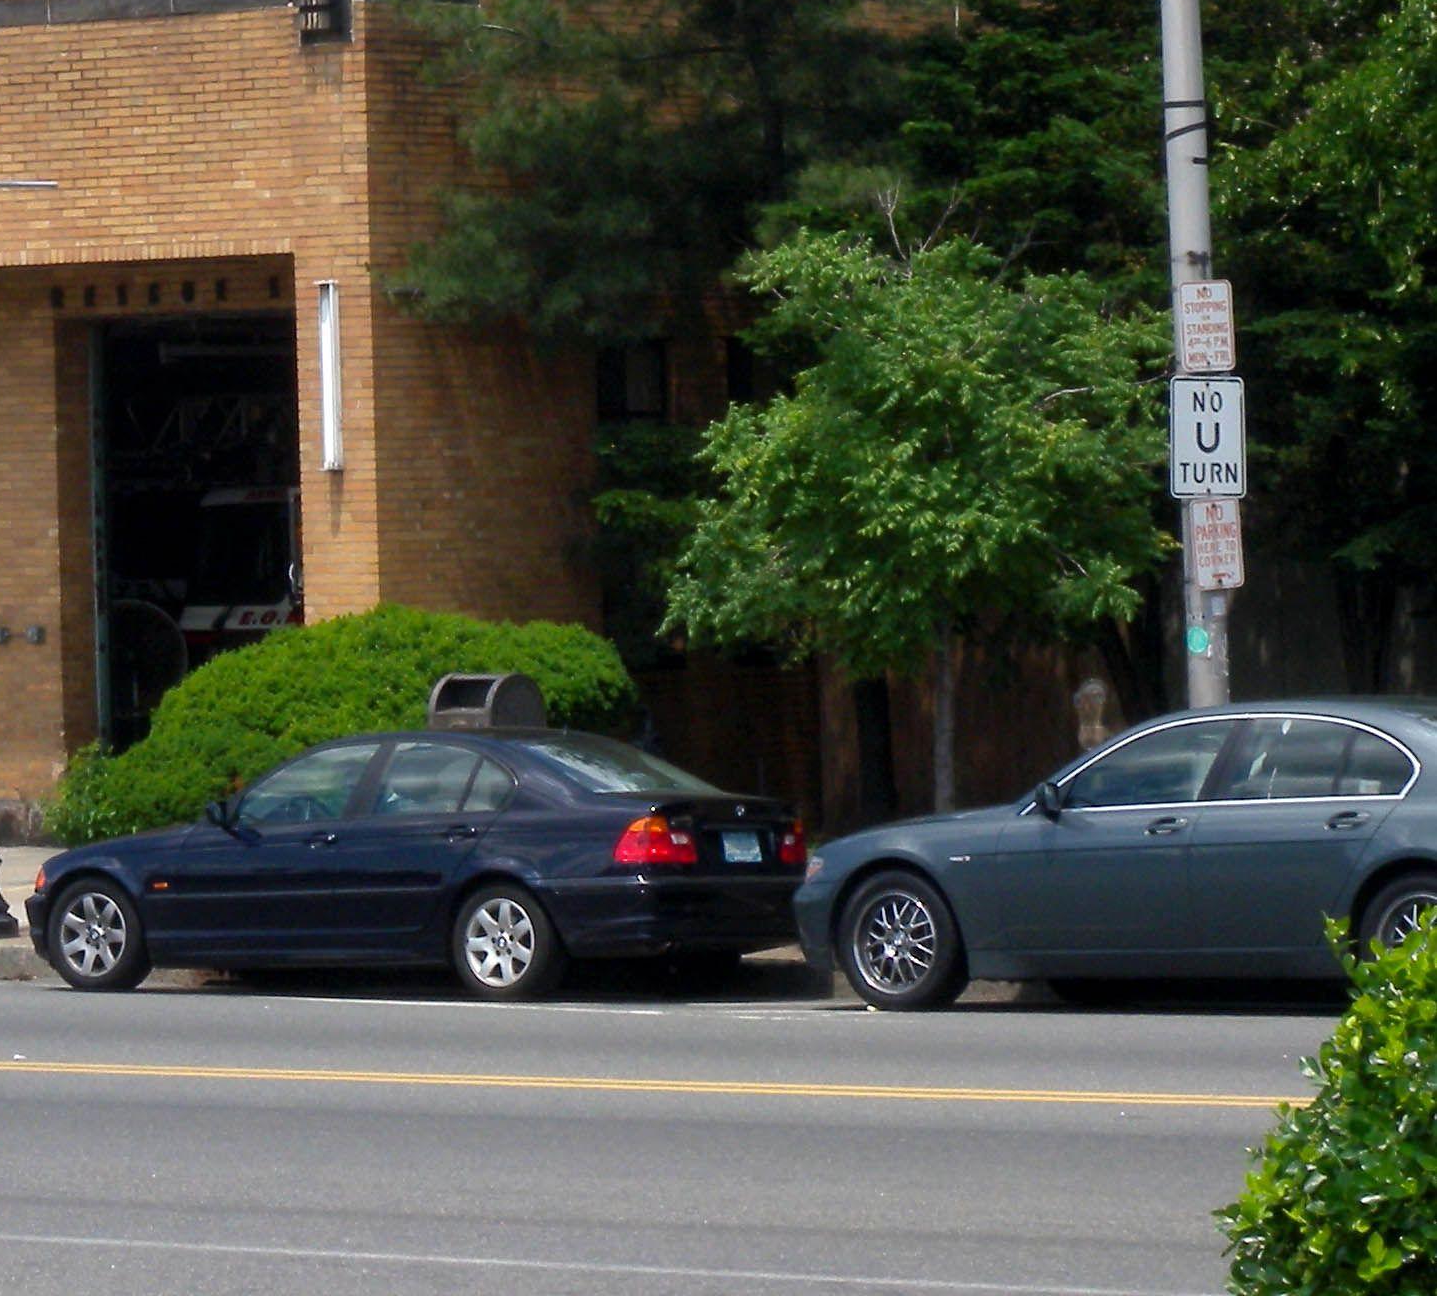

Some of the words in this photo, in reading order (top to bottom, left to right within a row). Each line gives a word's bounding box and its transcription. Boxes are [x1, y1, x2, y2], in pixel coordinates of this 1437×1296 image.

[1196, 287, 1212, 299] NO
[1184, 301, 1227, 314] STOPPING
[1186, 322, 1229, 335] STANDING
[1193, 391, 1223, 413] NO
[1196, 422, 1220, 453] U
[1180, 462, 1238, 483] TURN
[1206, 504, 1223, 521] NO
[1196, 522, 1236, 541] PARKING
